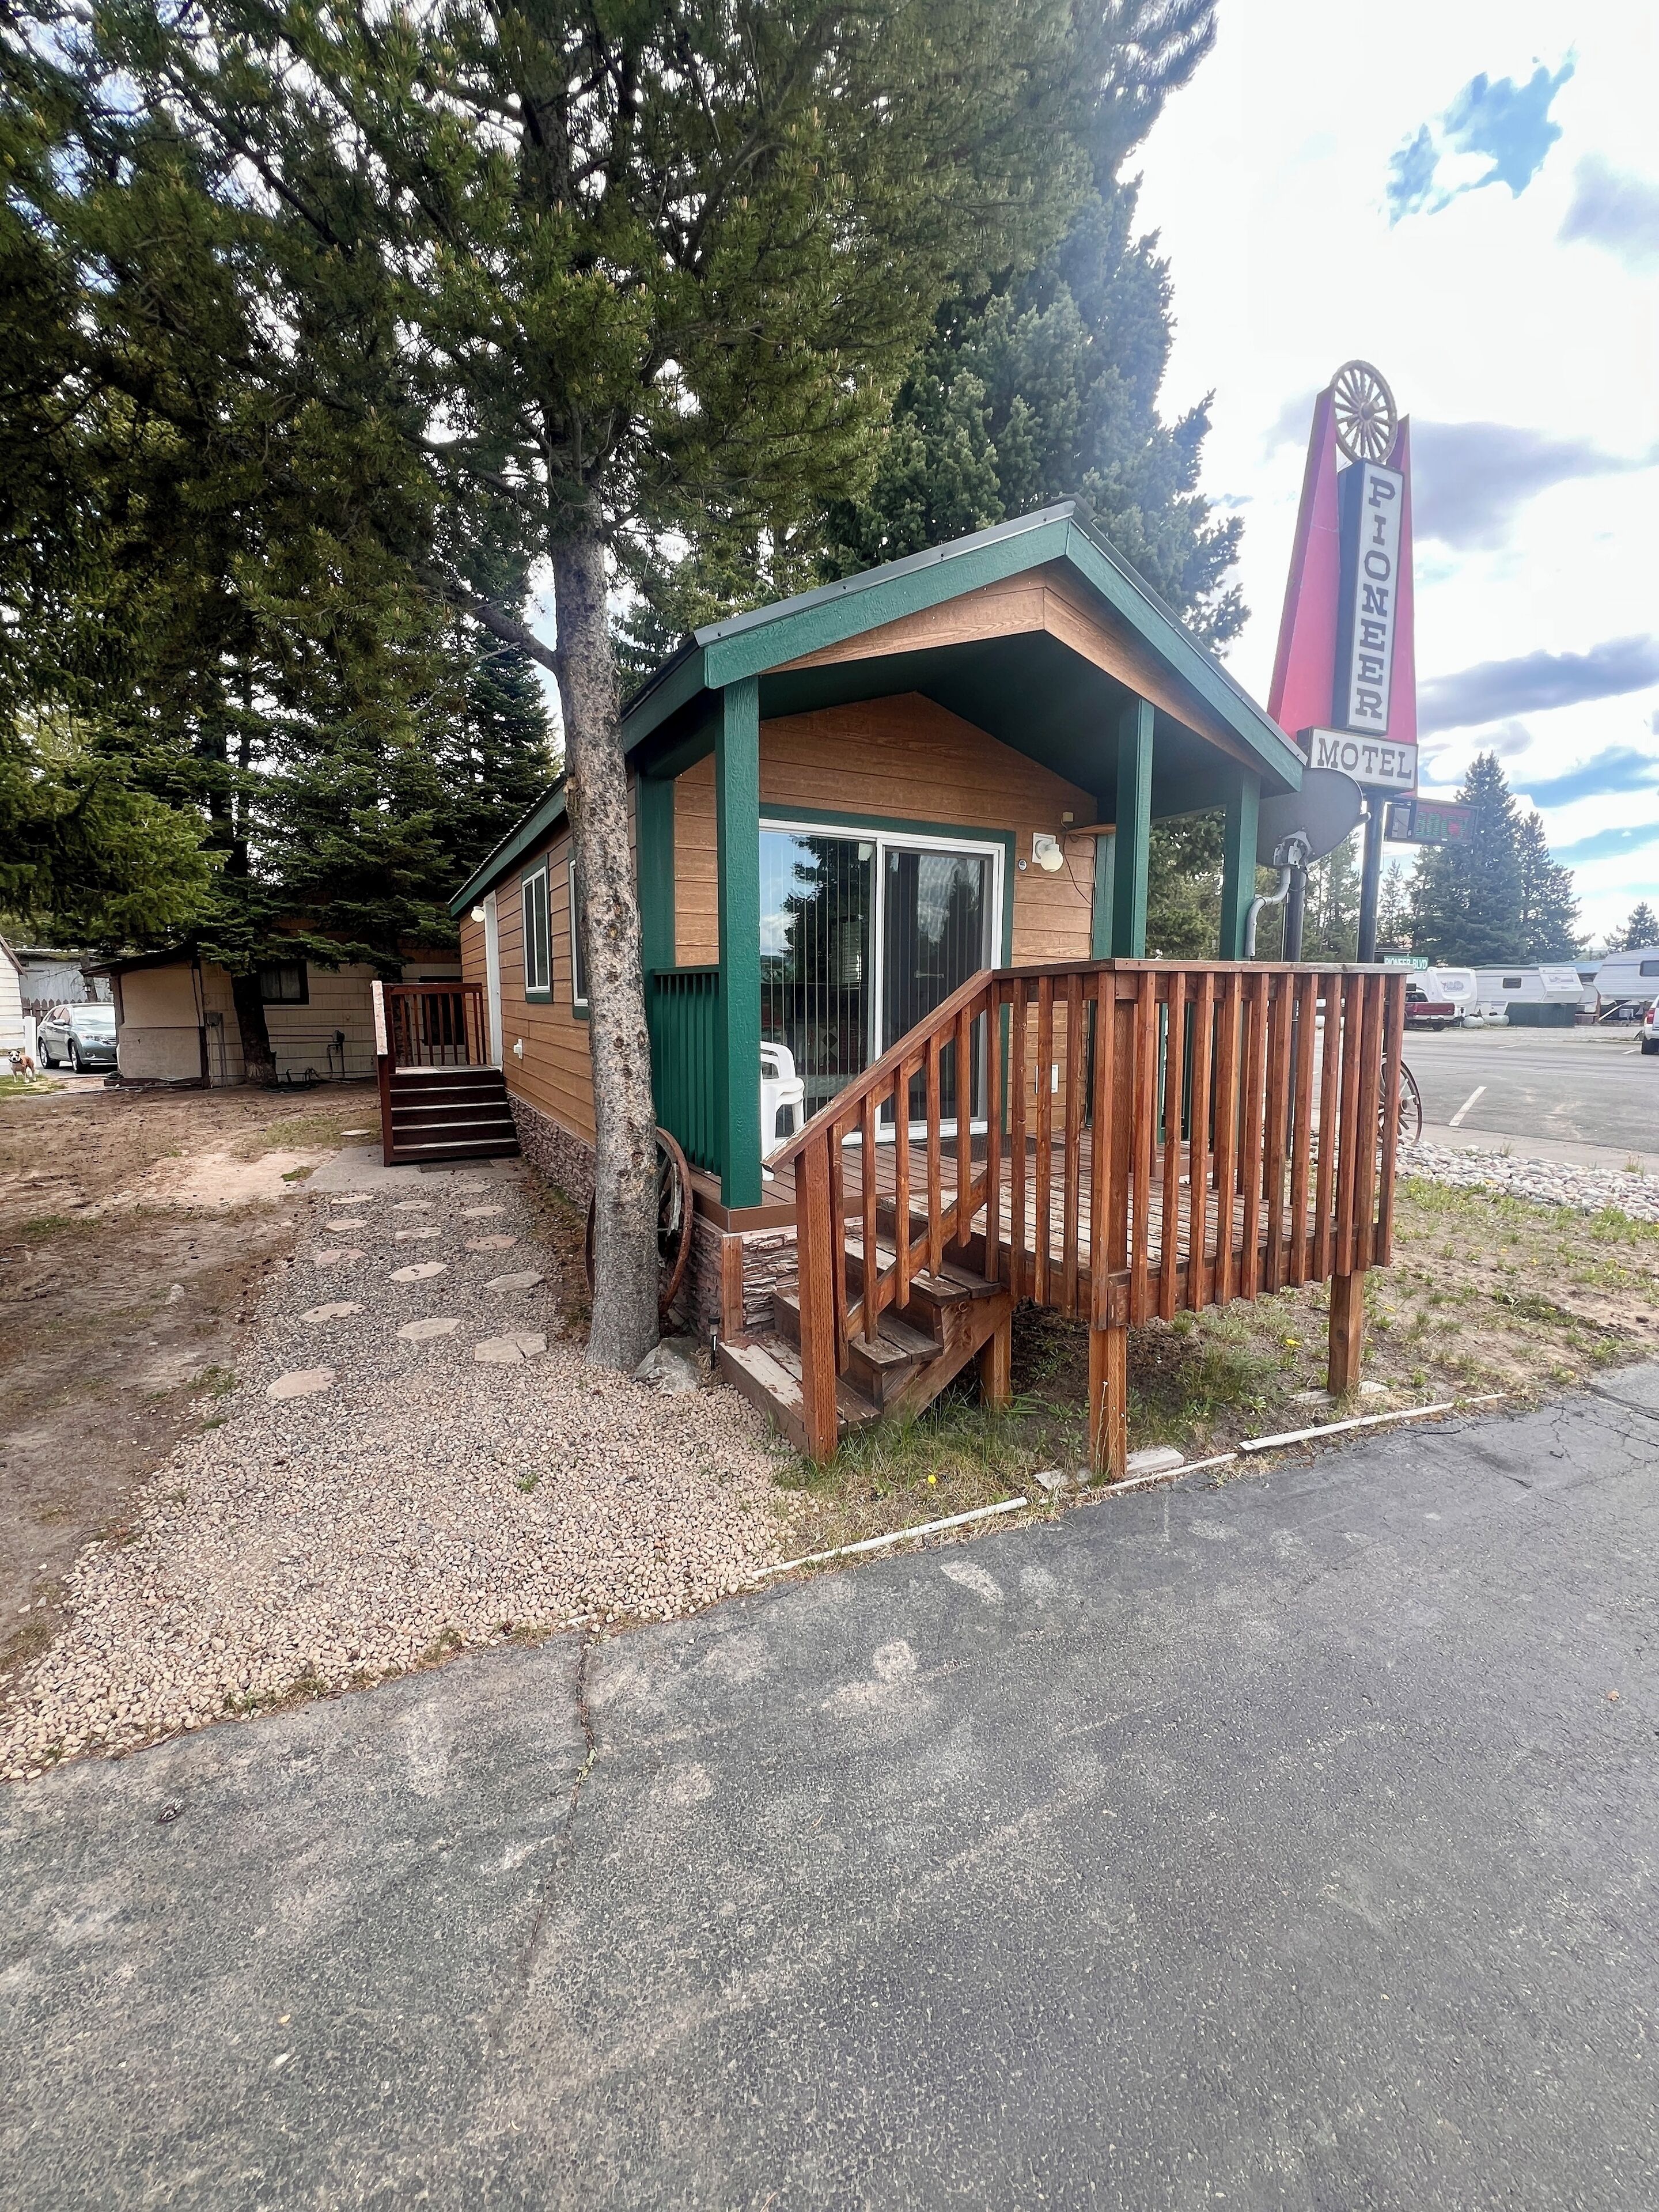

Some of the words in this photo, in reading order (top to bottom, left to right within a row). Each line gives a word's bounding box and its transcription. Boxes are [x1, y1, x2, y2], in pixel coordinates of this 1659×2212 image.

[1355, 476, 1396, 719] PIONEER
[1317, 737, 1412, 779] MOTEL
[1413, 959, 1427, 969] BLVD
